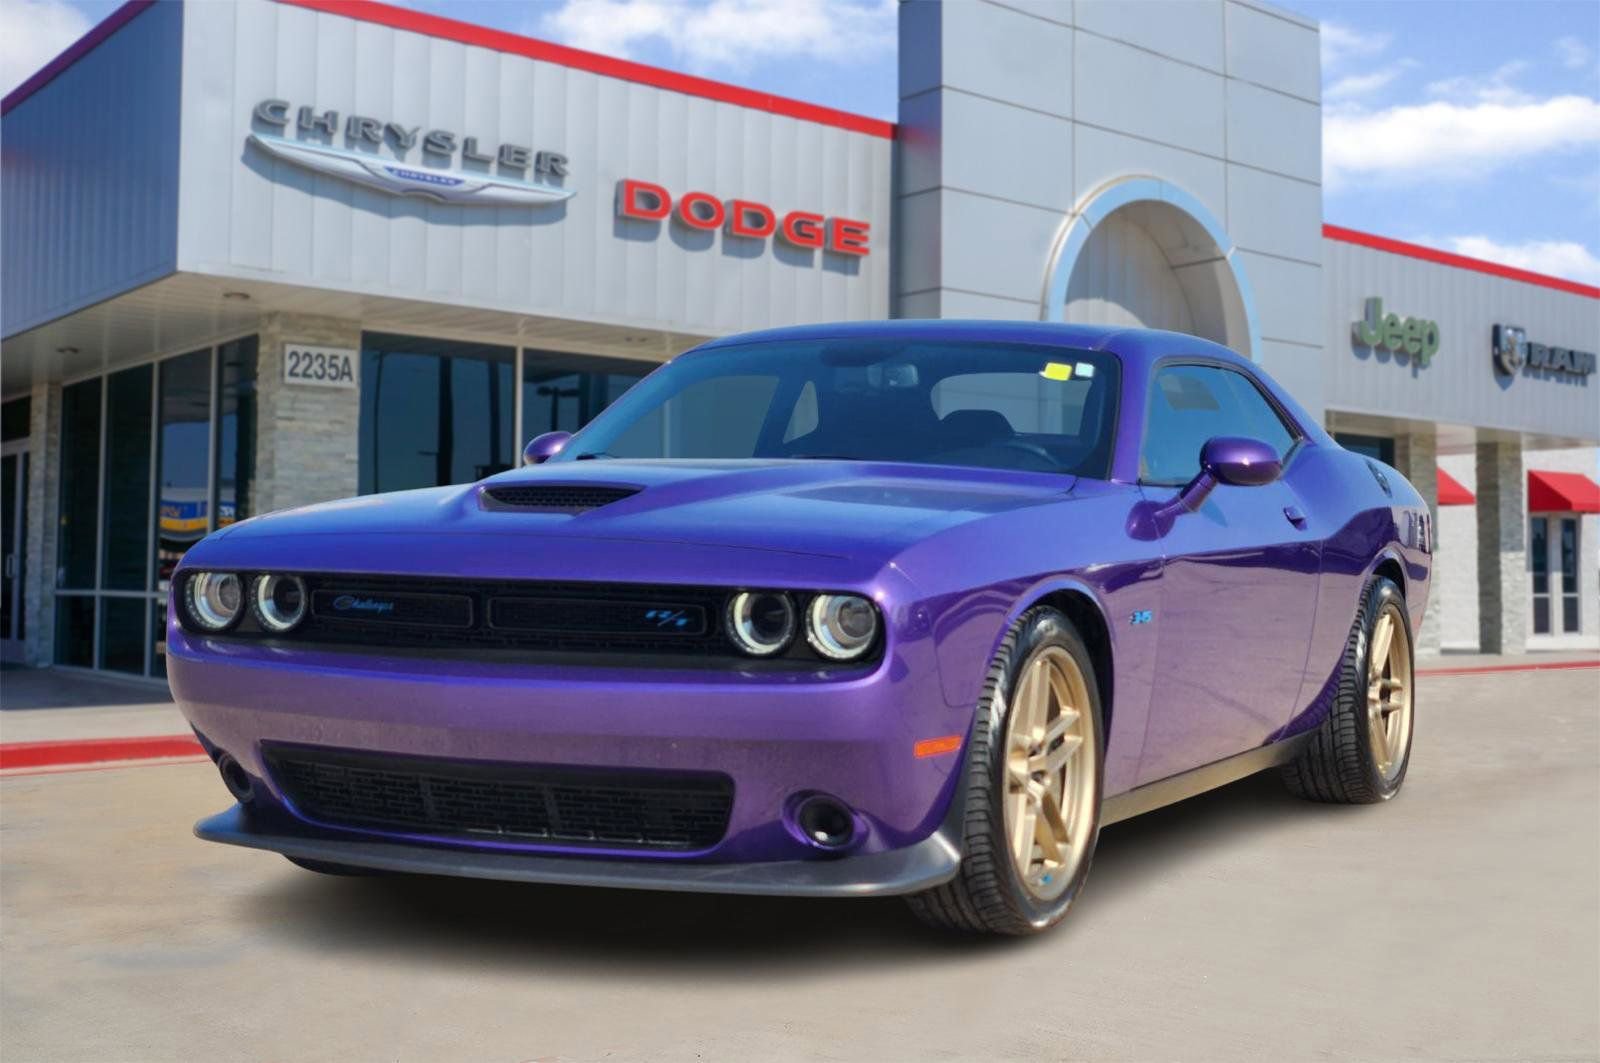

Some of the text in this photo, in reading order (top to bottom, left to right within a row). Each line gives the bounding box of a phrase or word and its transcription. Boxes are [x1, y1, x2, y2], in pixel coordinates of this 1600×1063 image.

[251, 98, 569, 178] CHRYSLER
[615, 178, 870, 256] DODGE
[288, 350, 354, 383] 2235A
[1352, 297, 1440, 367] Jeep
[1526, 341, 1597, 374] RAM
